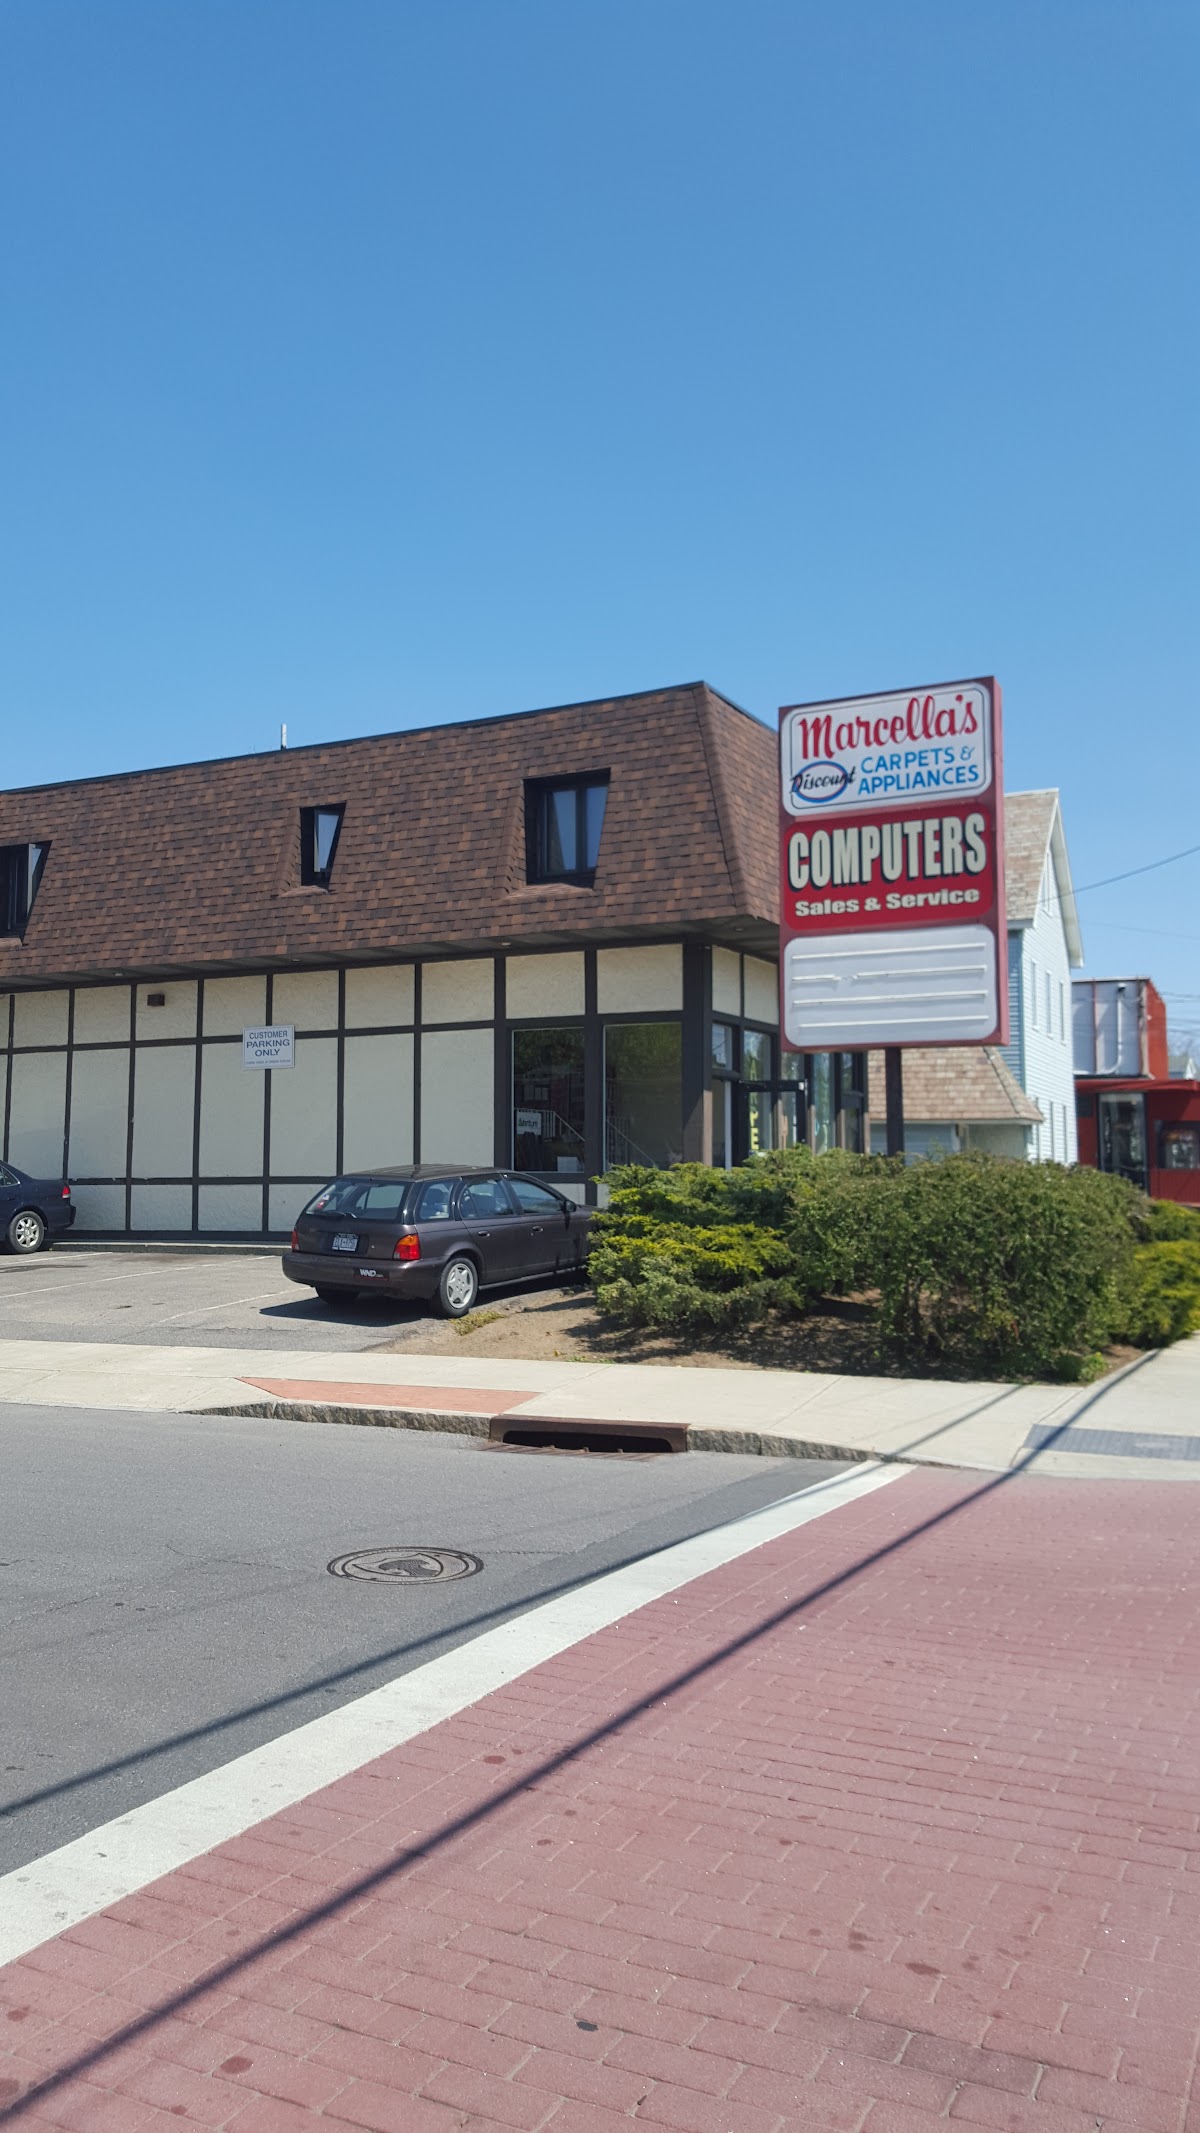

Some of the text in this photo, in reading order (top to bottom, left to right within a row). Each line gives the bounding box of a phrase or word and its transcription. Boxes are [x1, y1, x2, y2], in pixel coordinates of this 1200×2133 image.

[799, 694, 978, 760] Marcella's
[860, 746, 976, 774] CARPETS &
[789, 765, 857, 794] Discount
[858, 765, 979, 795] APPLIANCES
[788, 812, 987, 891] COMPUTERS
[795, 888, 980, 917] Sales & Service
[246, 1039, 290, 1048] PARKING
[249, 1030, 288, 1040] CUSTOMER
[254, 1048, 280, 1057] ONLY
